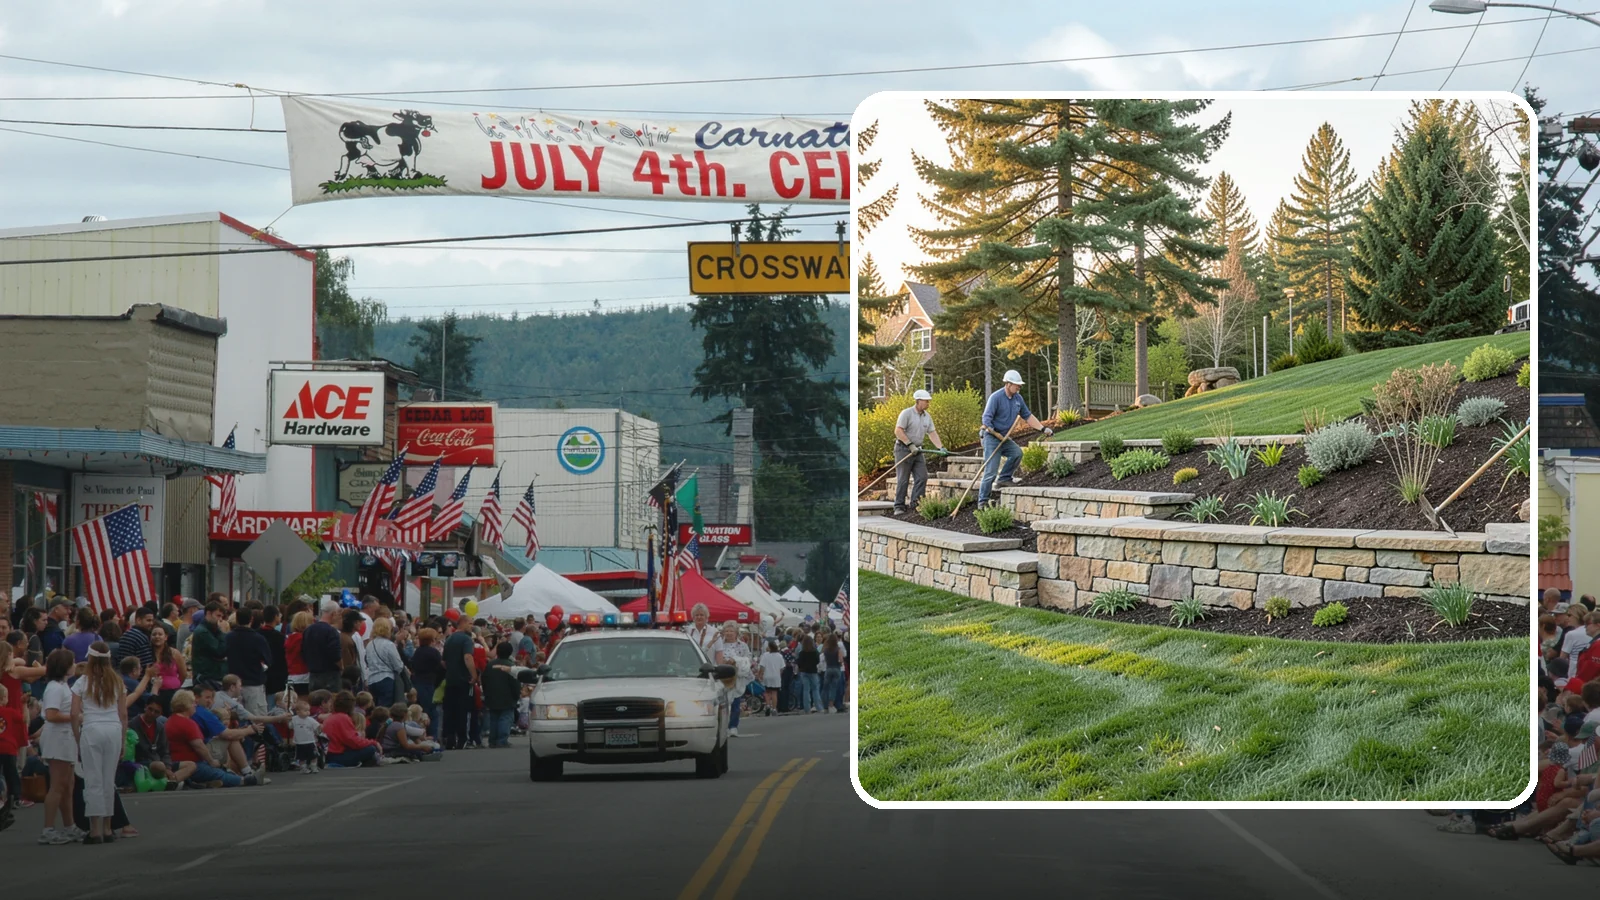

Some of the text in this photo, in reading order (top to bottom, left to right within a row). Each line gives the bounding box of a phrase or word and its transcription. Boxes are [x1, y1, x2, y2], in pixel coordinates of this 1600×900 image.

[695, 121, 850, 149] Carnat
[481, 141, 605, 192] JULY
[632, 150, 746, 197] 4th.
[697, 254, 850, 280] CROSSWA
[283, 380, 373, 419] ACE
[406, 409, 484, 421] CEDAR LOG
[284, 421, 370, 436] Hardware
[416, 428, 477, 447] Coca-Cola
[83, 485, 155, 495] St. Vincent de Paul
[688, 526, 741, 535] CRNATION
[699, 535, 730, 543] GLASS
